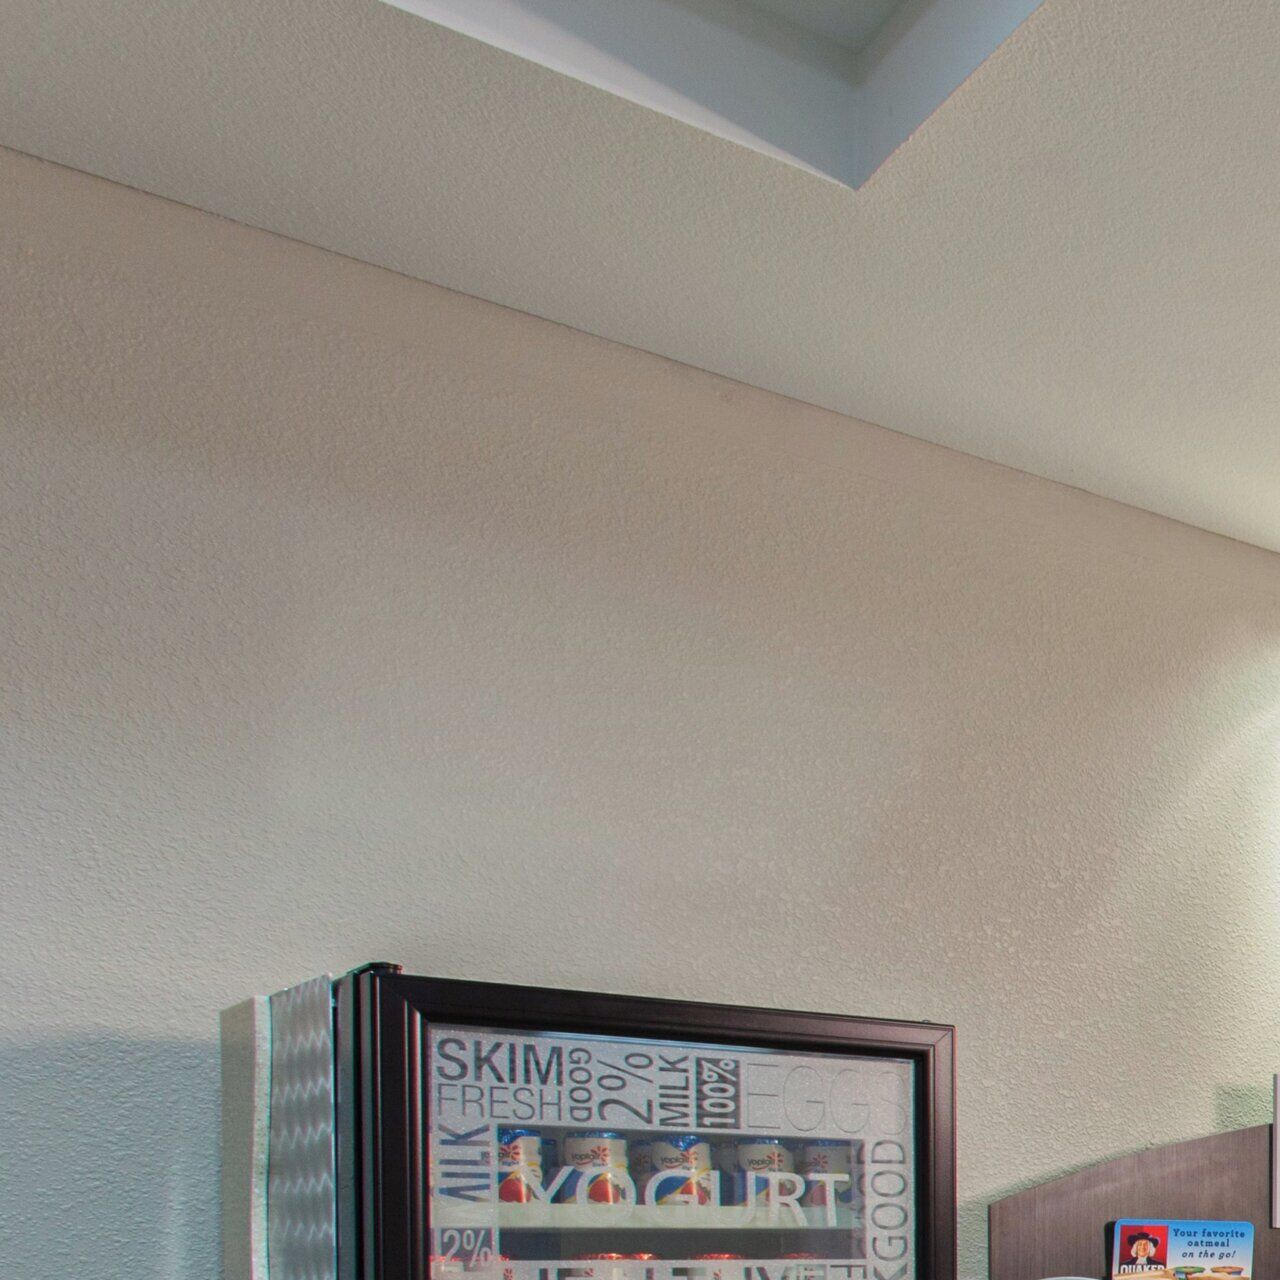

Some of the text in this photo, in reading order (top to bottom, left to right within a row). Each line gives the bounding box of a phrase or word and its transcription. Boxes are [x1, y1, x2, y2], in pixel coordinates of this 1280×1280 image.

[436, 1037, 564, 1087] SKIM
[568, 1047, 593, 1122] GOOD
[597, 1052, 654, 1125] 2%
[658, 1053, 691, 1128] MILK
[702, 1058, 737, 1127] 100%
[436, 1083, 563, 1122] FRESH
[747, 1062, 907, 1136] EGGS
[518, 1163, 850, 1230] YOGURT
[870, 1139, 908, 1262] GOOD
[442, 1229, 493, 1268] 2%
[1173, 1228, 1246, 1239] Your favorite
[1181, 1249, 1237, 1261] on the go!
[1187, 1238, 1230, 1248] oatmeal
